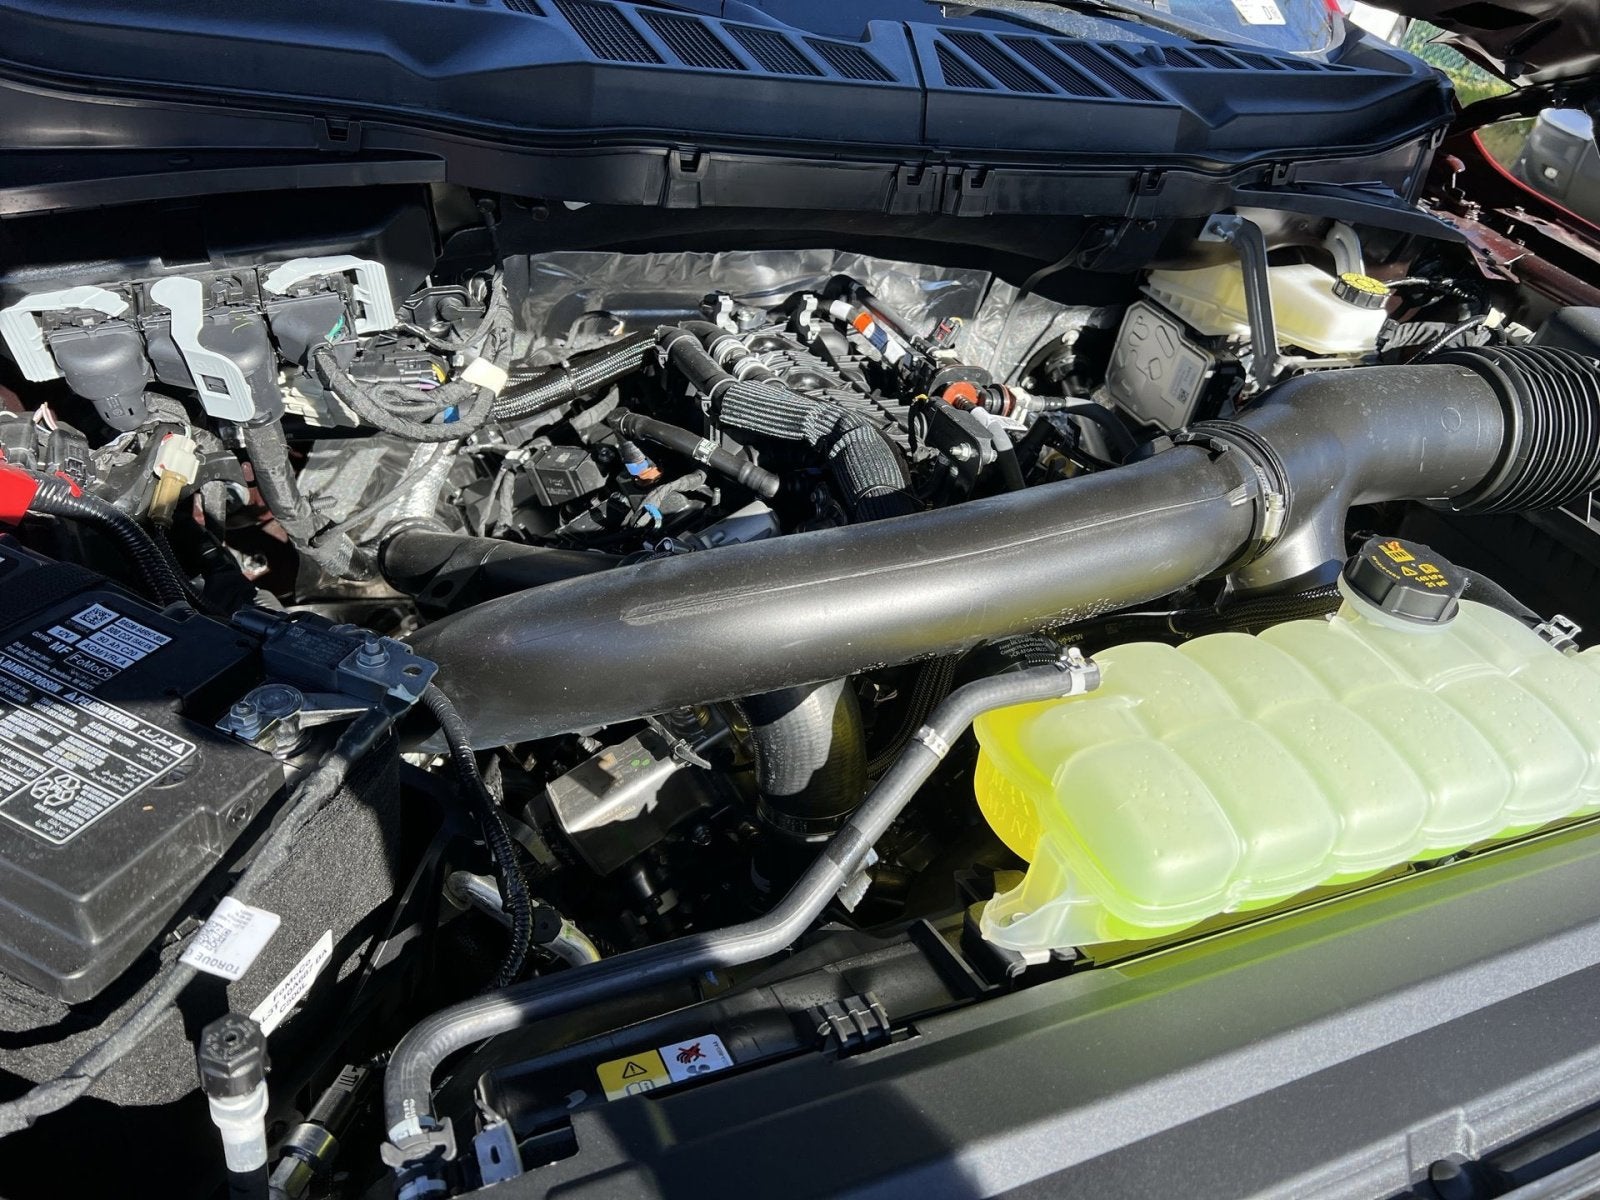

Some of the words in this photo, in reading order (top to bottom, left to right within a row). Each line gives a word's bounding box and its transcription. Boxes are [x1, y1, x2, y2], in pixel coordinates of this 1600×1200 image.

[56, 629, 73, 639] 12V
[48, 641, 73, 655] MF
[82, 642, 126, 665] AGM/VRLA
[108, 641, 121, 649] Ah
[120, 646, 137, 656] C20
[0, 660, 64, 692] DANGER/POISON
[69, 654, 115, 678] FoMoCo
[73, 696, 140, 730] PELIGRO/VENENO
[194, 954, 240, 975] TORQUE
[272, 958, 312, 1002] FoMoCo
